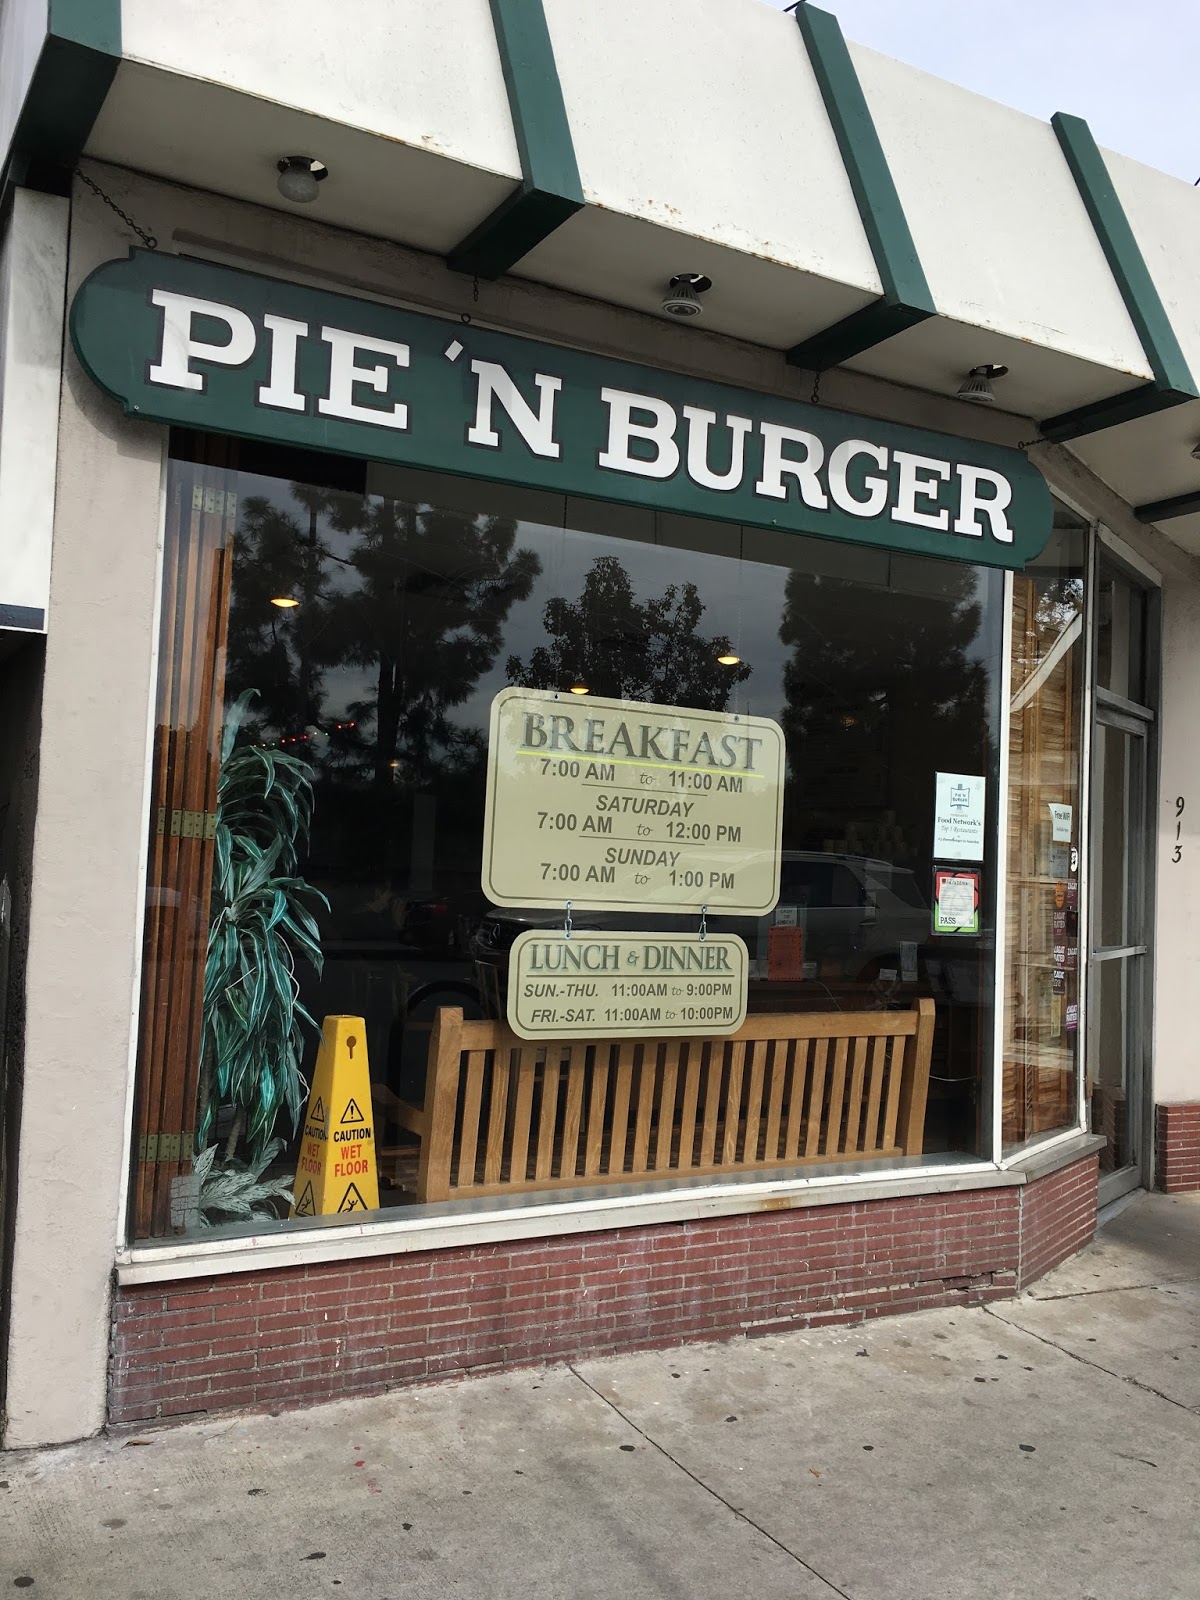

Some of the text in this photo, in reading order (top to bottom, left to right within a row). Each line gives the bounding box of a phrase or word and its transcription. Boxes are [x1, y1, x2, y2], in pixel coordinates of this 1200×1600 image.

[149, 288, 1014, 543] PIE 'N BURGER
[521, 711, 763, 770] BREAKFAST
[540, 758, 743, 793] 7:00 AM to 11:00 AM
[595, 794, 695, 818] SATURDAY
[1054, 810, 1063, 820] Free
[537, 811, 742, 843] 7:00 AM to 12:00 PM
[952, 817, 982, 827] Network's
[604, 847, 682, 867] SUNDAY
[540, 862, 735, 889] 7:00 AM to 1:00 PM
[939, 916, 957, 925] PASS
[529, 943, 733, 971] LUNCH & DINNER
[523, 983, 733, 998] SUN.-THU. 11:00AM to 9:00PM
[530, 1006, 734, 1023] FRI.-SAT. 11:00AM to 10:00PM
[304, 1125, 328, 1142] CAUTION
[333, 1127, 372, 1142] CAUTION
[307, 1141, 319, 1157] WET
[341, 1144, 362, 1160] WET
[301, 1157, 322, 1176] FLOOR
[334, 1160, 369, 1178] FLOOR
